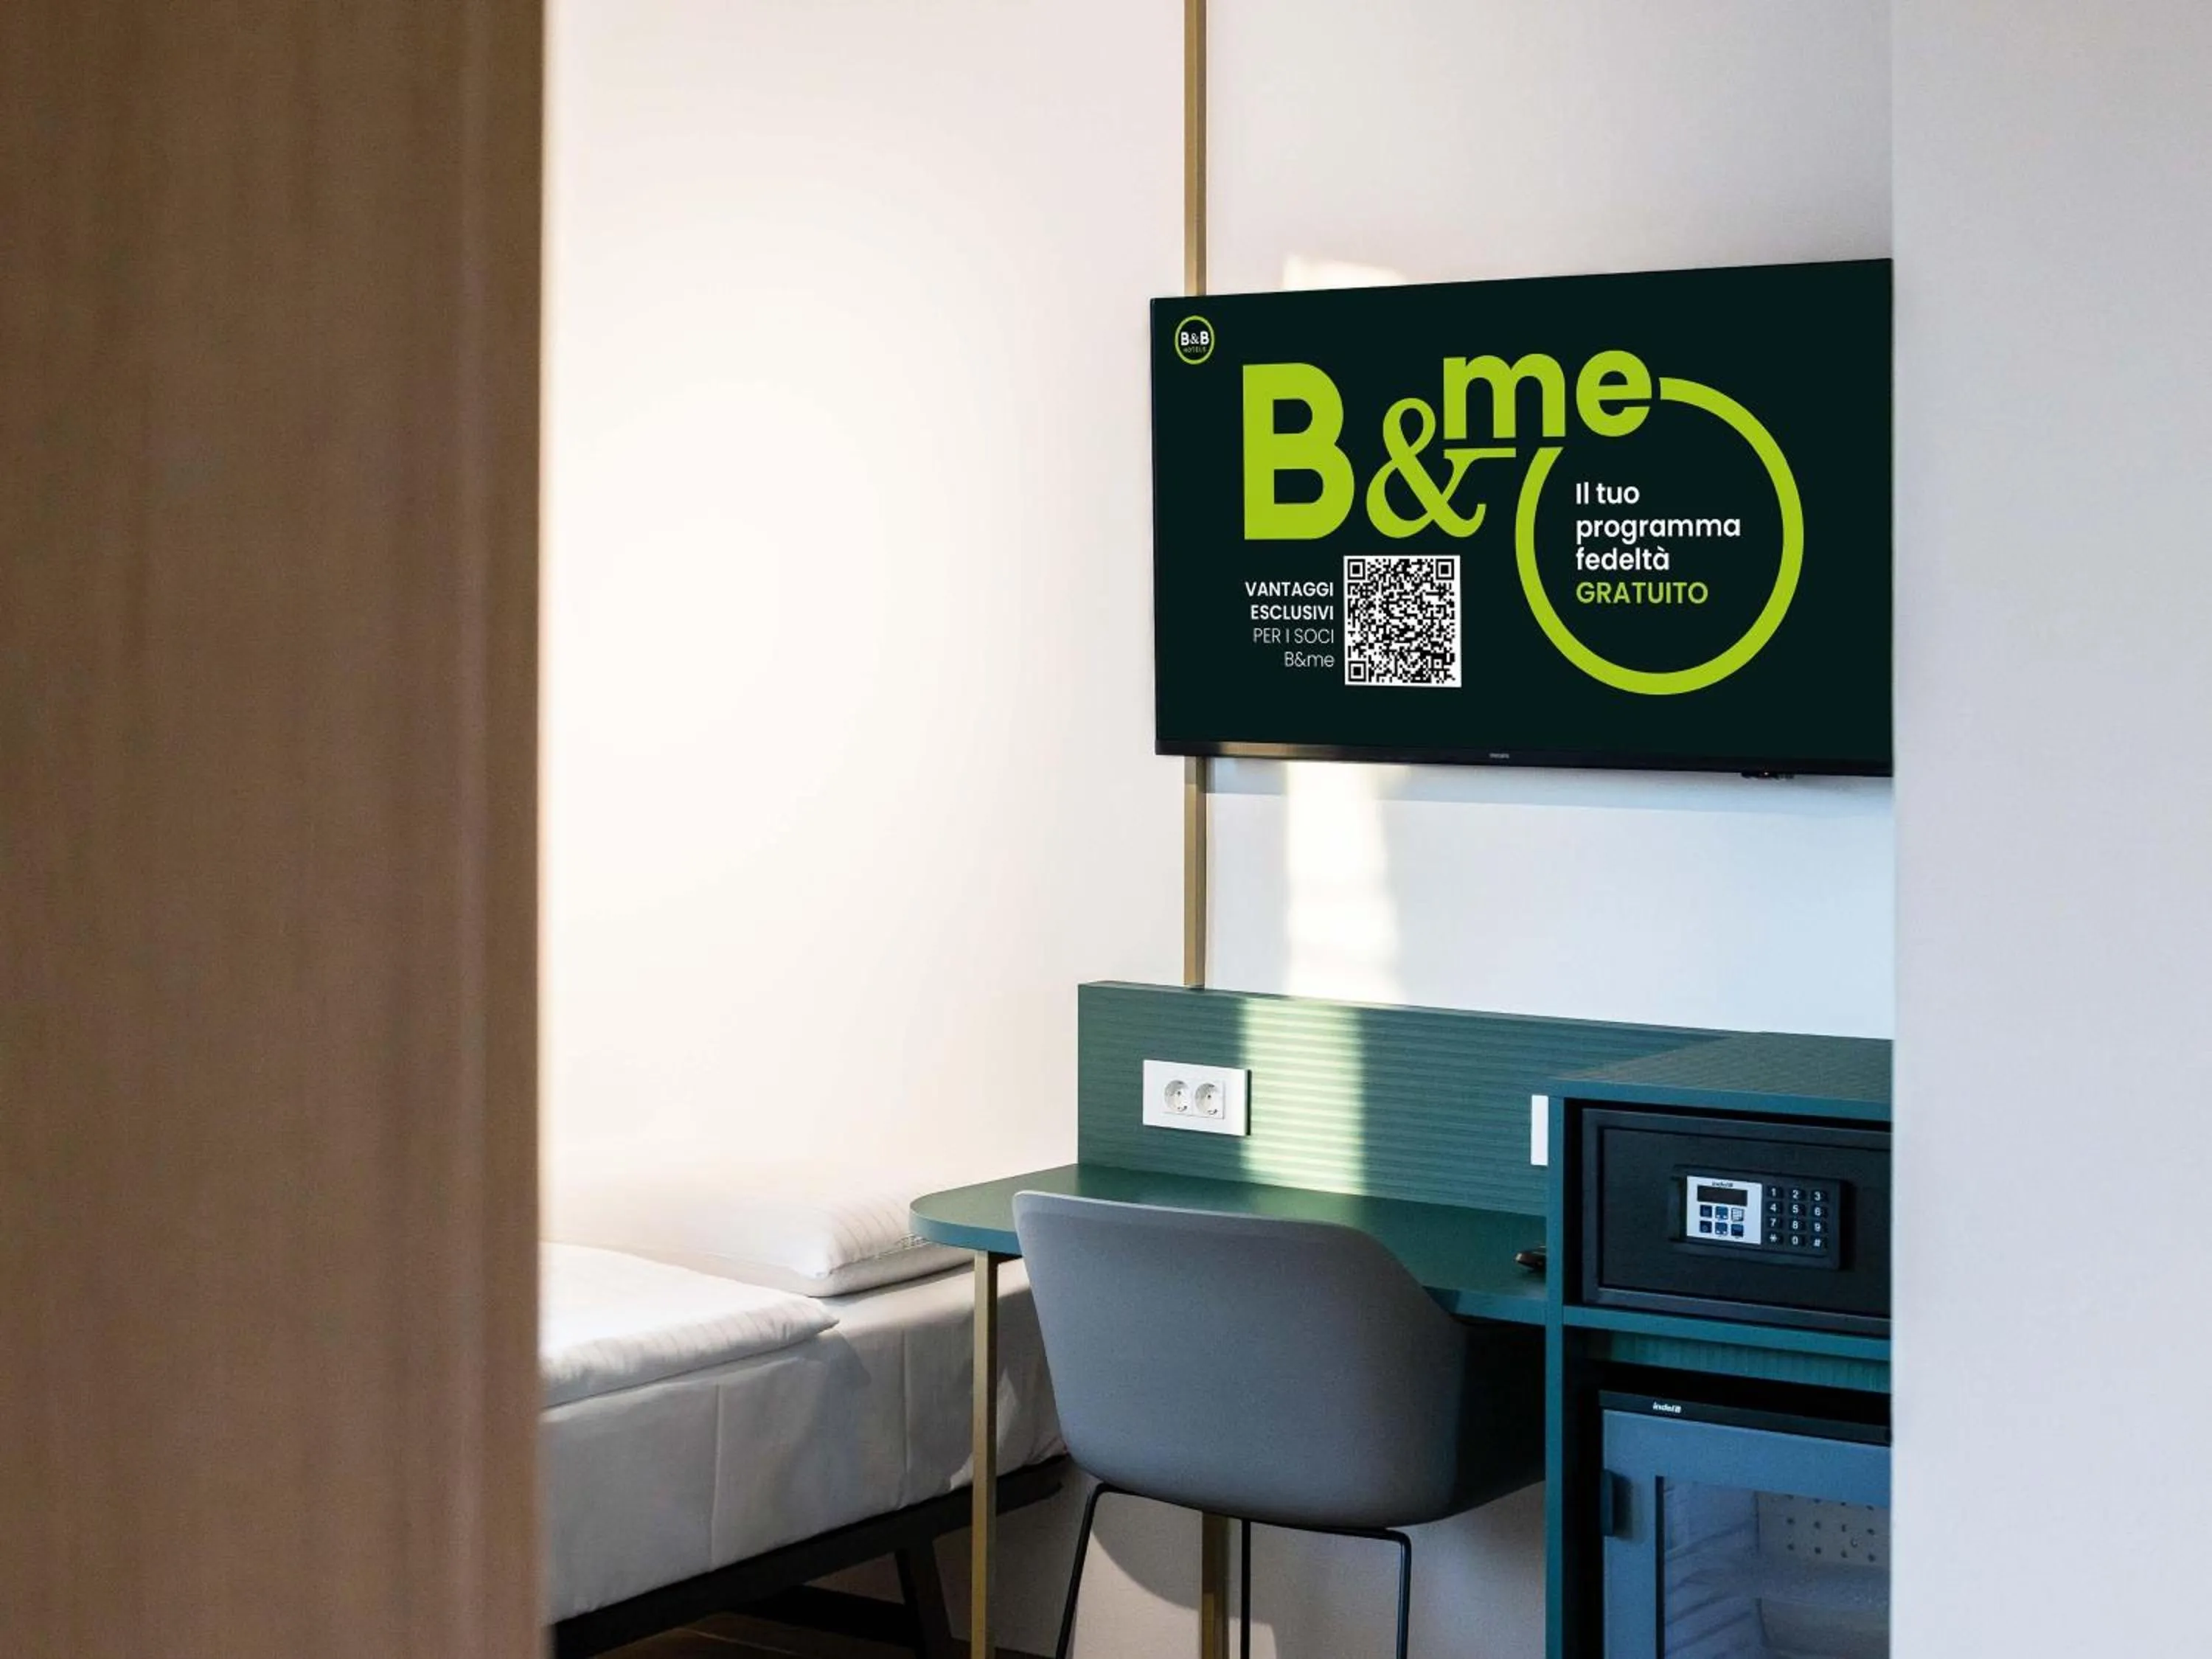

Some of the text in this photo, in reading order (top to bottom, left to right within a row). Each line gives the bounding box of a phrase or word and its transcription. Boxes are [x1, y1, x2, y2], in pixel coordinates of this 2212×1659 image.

[1180, 330, 1210, 346] B&B
[1576, 481, 1641, 504] Il tuo
[1576, 518, 1742, 545] programma
[1576, 546, 1670, 571] fedeltà
[1245, 581, 1334, 597] VANTAGGI
[1576, 581, 1709, 604] GRATUITO
[1251, 605, 1334, 620] ESCLUSIVI
[1253, 627, 1334, 644] PER I SOCI
[1284, 651, 1335, 667] B&me
[1771, 1188, 1821, 1201] 1 2 3
[1770, 1203, 1821, 1217] 4 5 6
[1770, 1217, 1821, 1232] 7 8 9
[1792, 1235, 1798, 1245] 0
